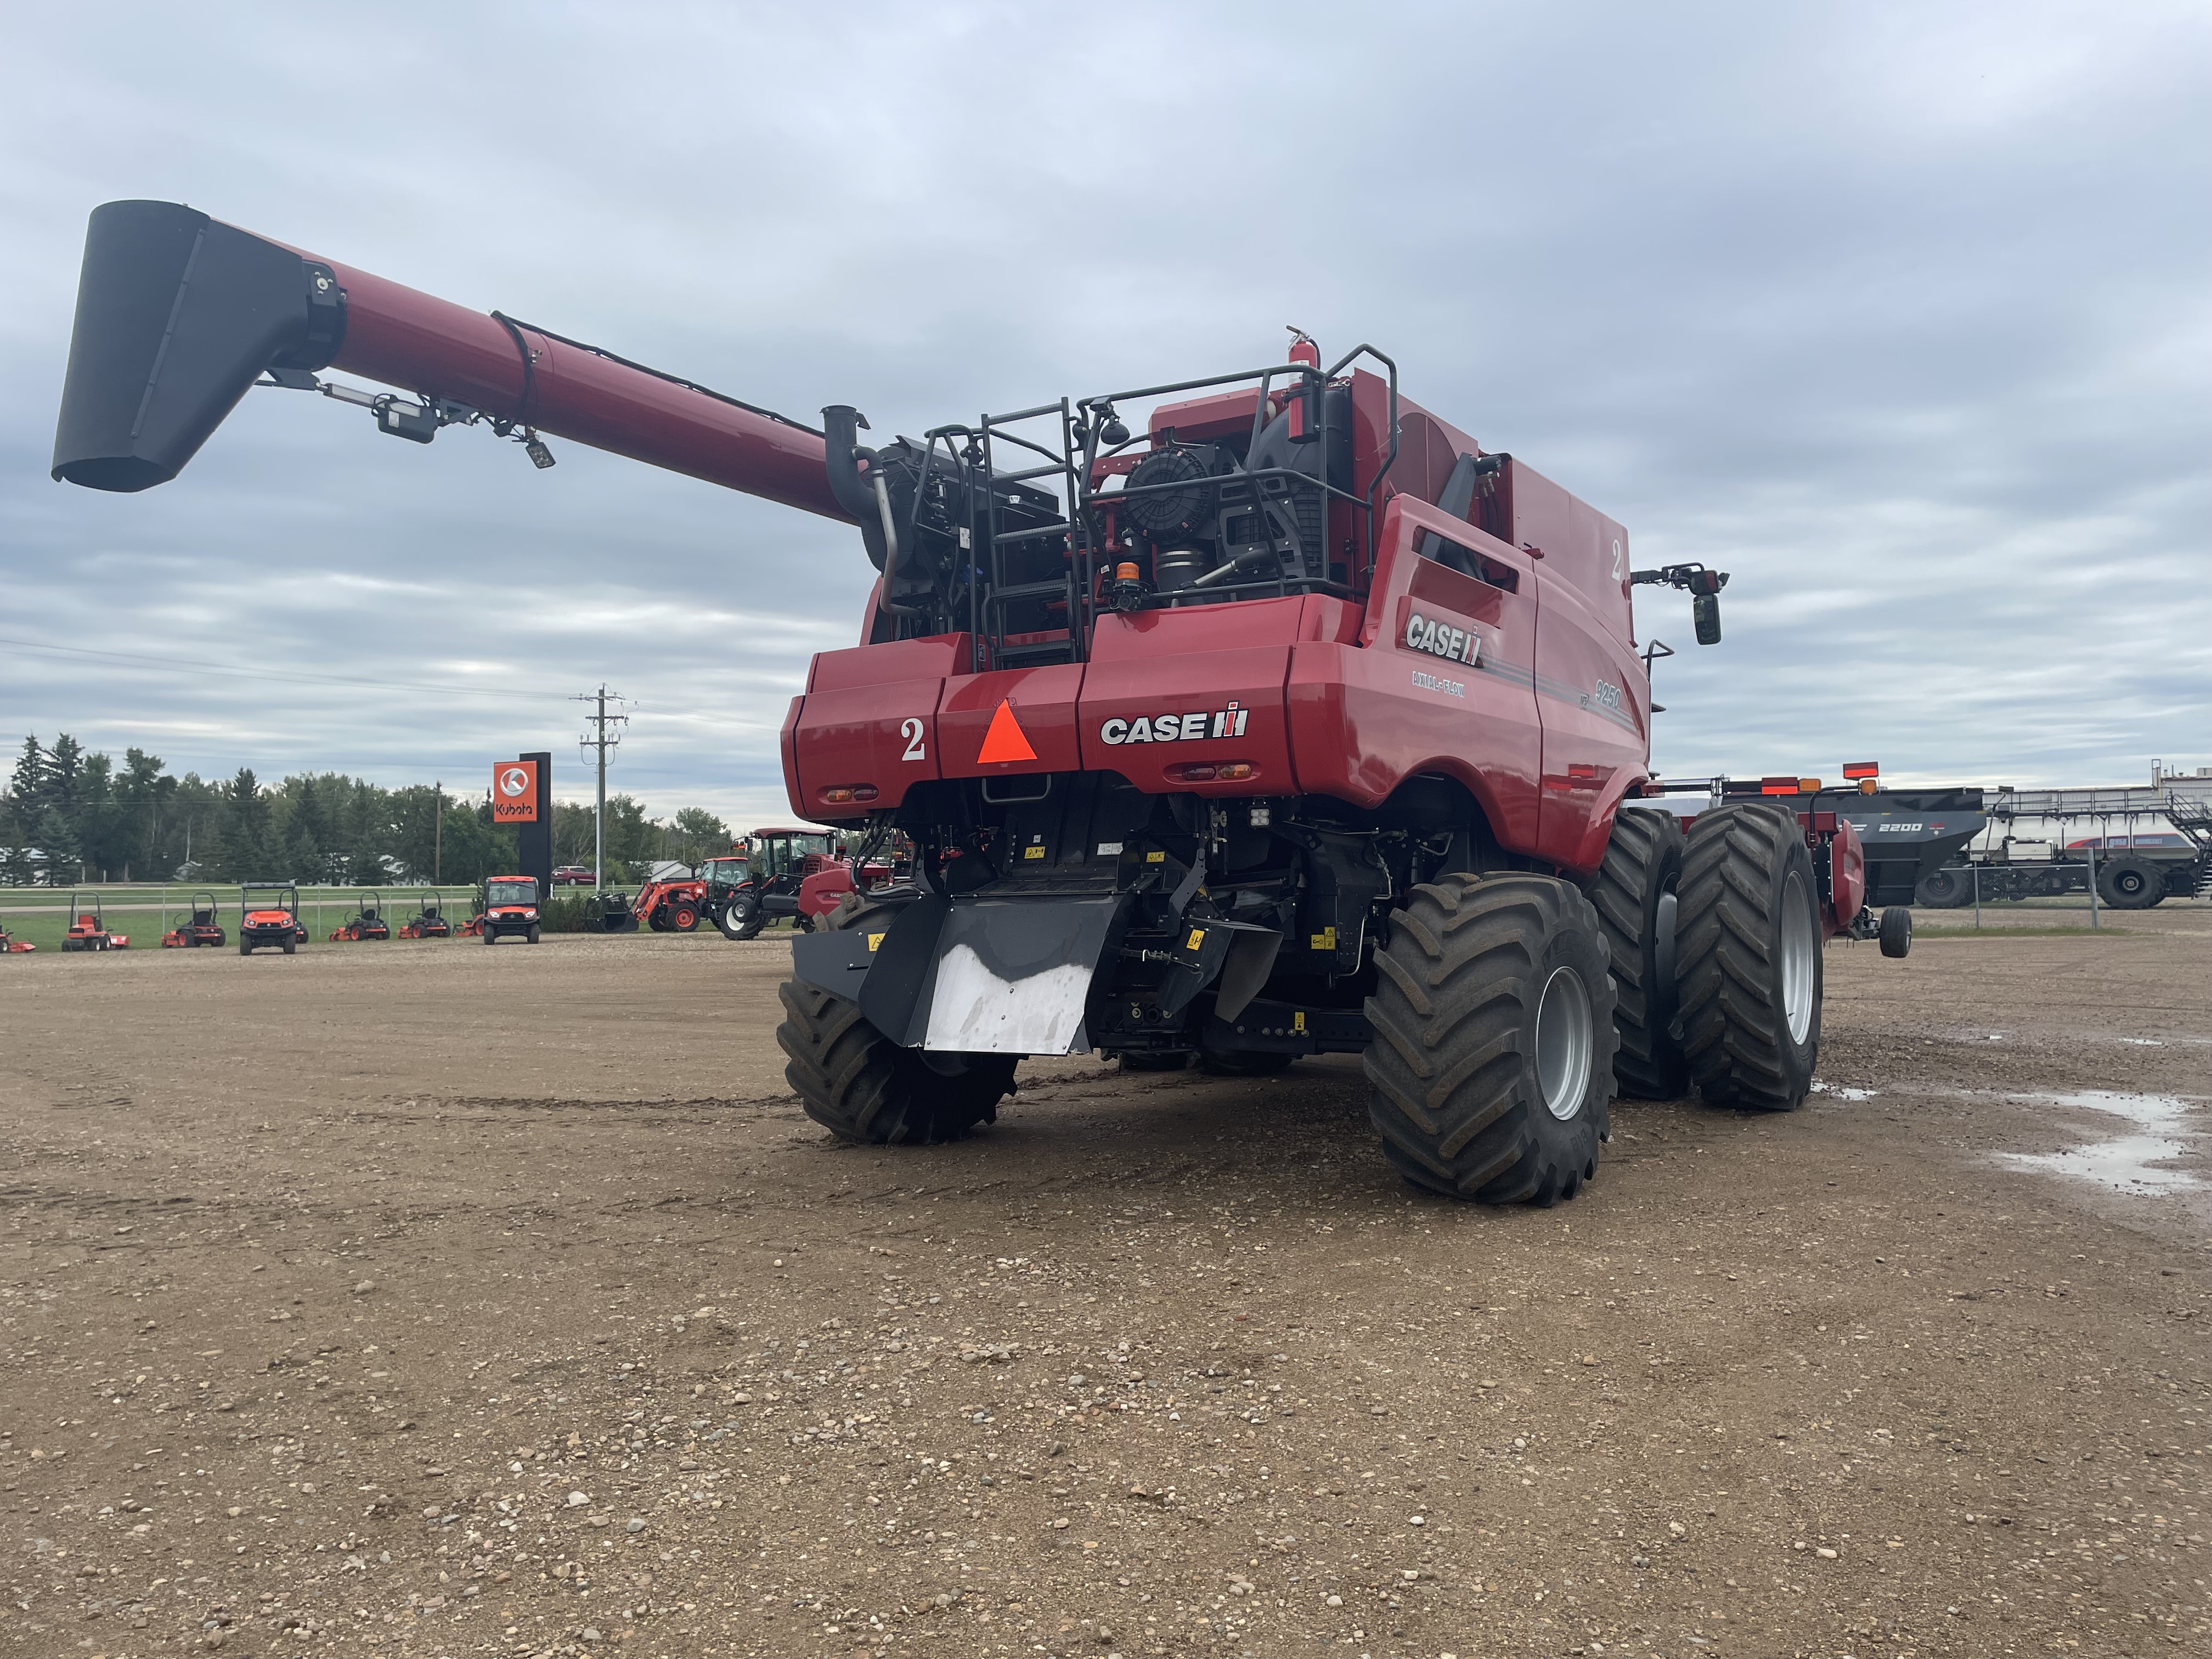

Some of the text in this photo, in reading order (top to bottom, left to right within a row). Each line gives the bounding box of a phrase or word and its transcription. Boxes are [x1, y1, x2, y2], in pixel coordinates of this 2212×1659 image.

[1611, 539, 1621, 582] 2
[1407, 614, 1464, 659] CASE
[1412, 670, 1465, 698] AXIAL-FLOW
[1595, 679, 1621, 712] 9250
[901, 718, 925, 761] 2
[1101, 713, 1207, 744] CASE
[496, 802, 532, 815] Kubota
[1878, 823, 1923, 832] 2200
